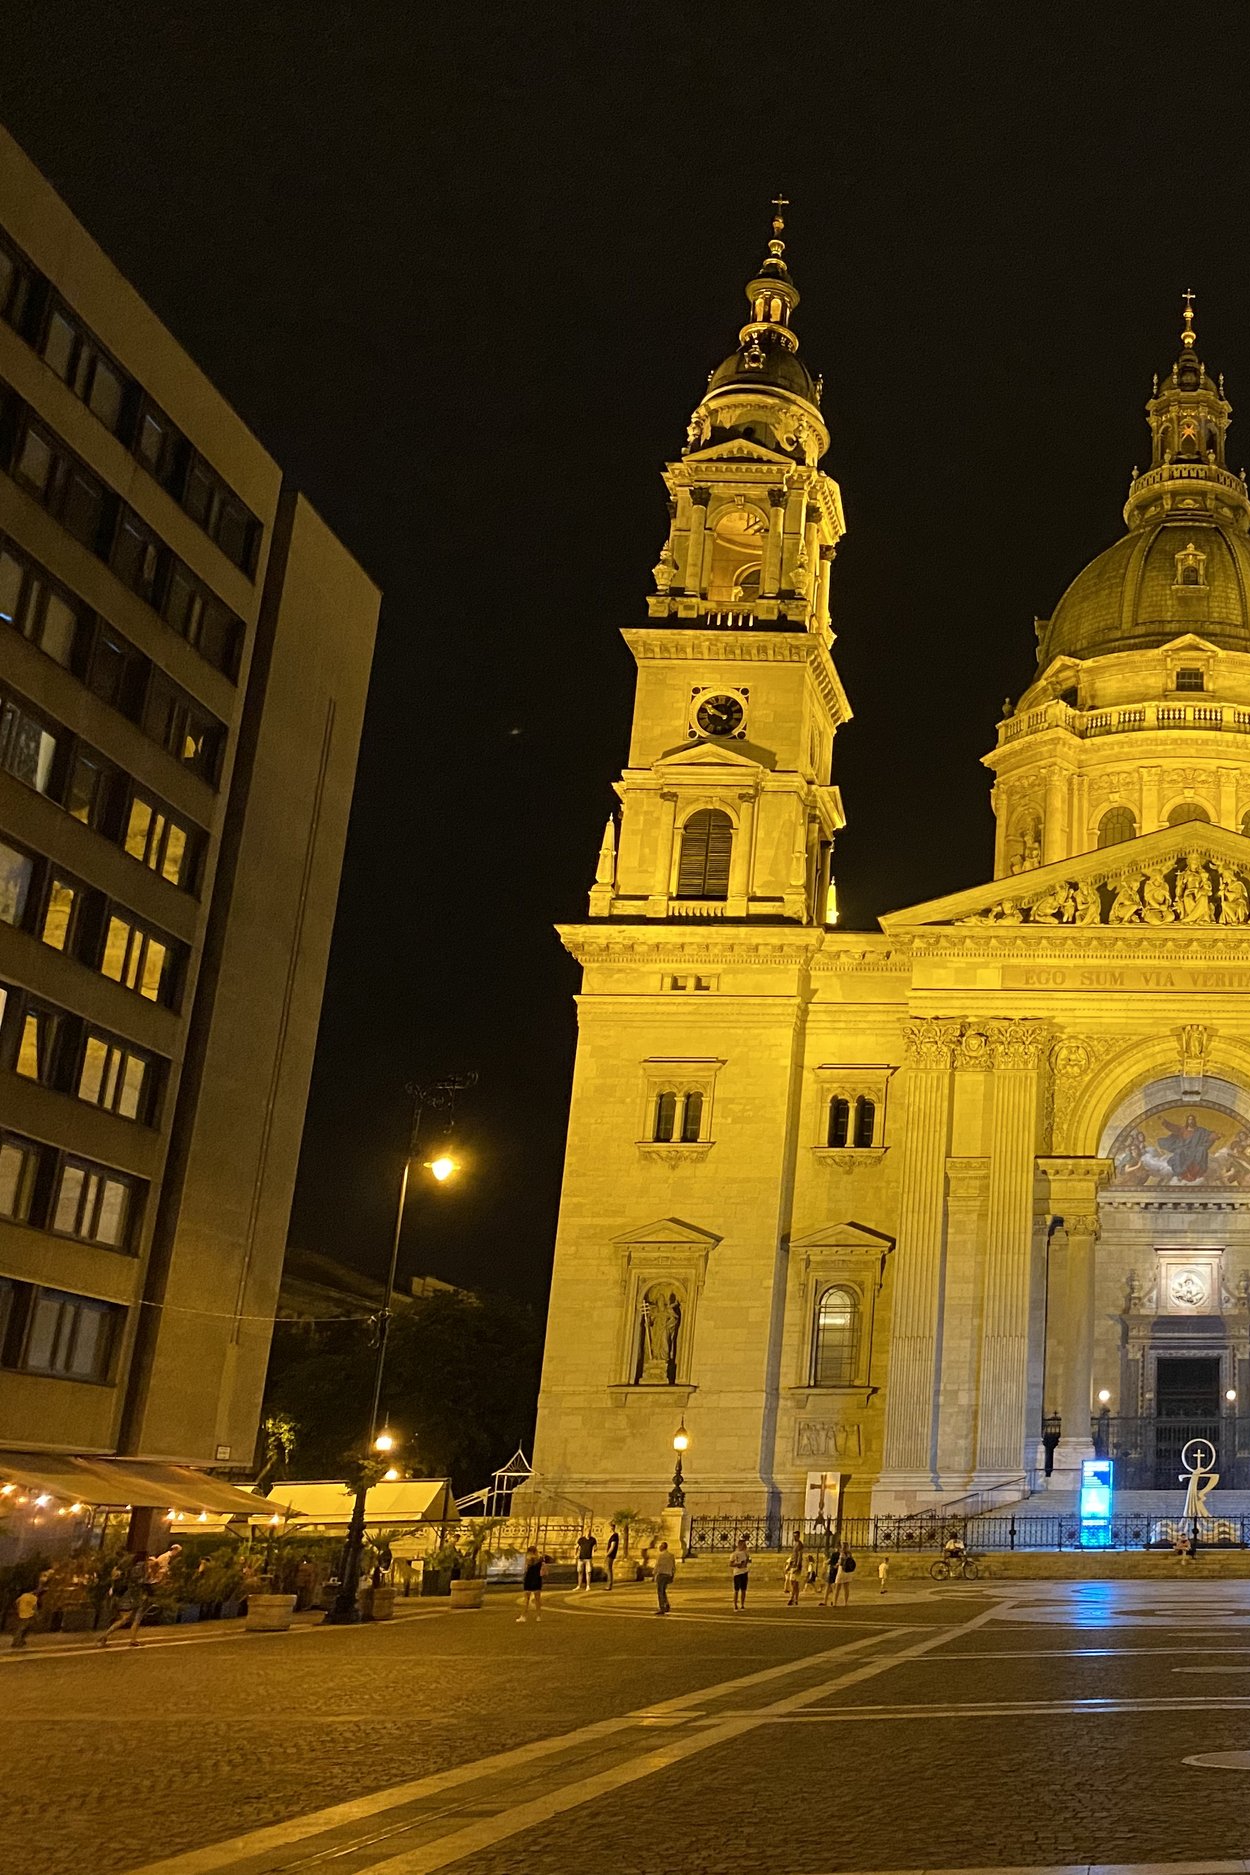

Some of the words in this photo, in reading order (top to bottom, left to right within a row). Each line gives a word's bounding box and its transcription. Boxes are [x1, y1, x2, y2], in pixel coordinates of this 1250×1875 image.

[1024, 970, 1066, 986] EGO
[1080, 971, 1125, 986] SUM
[1140, 972, 1175, 987] VIA
